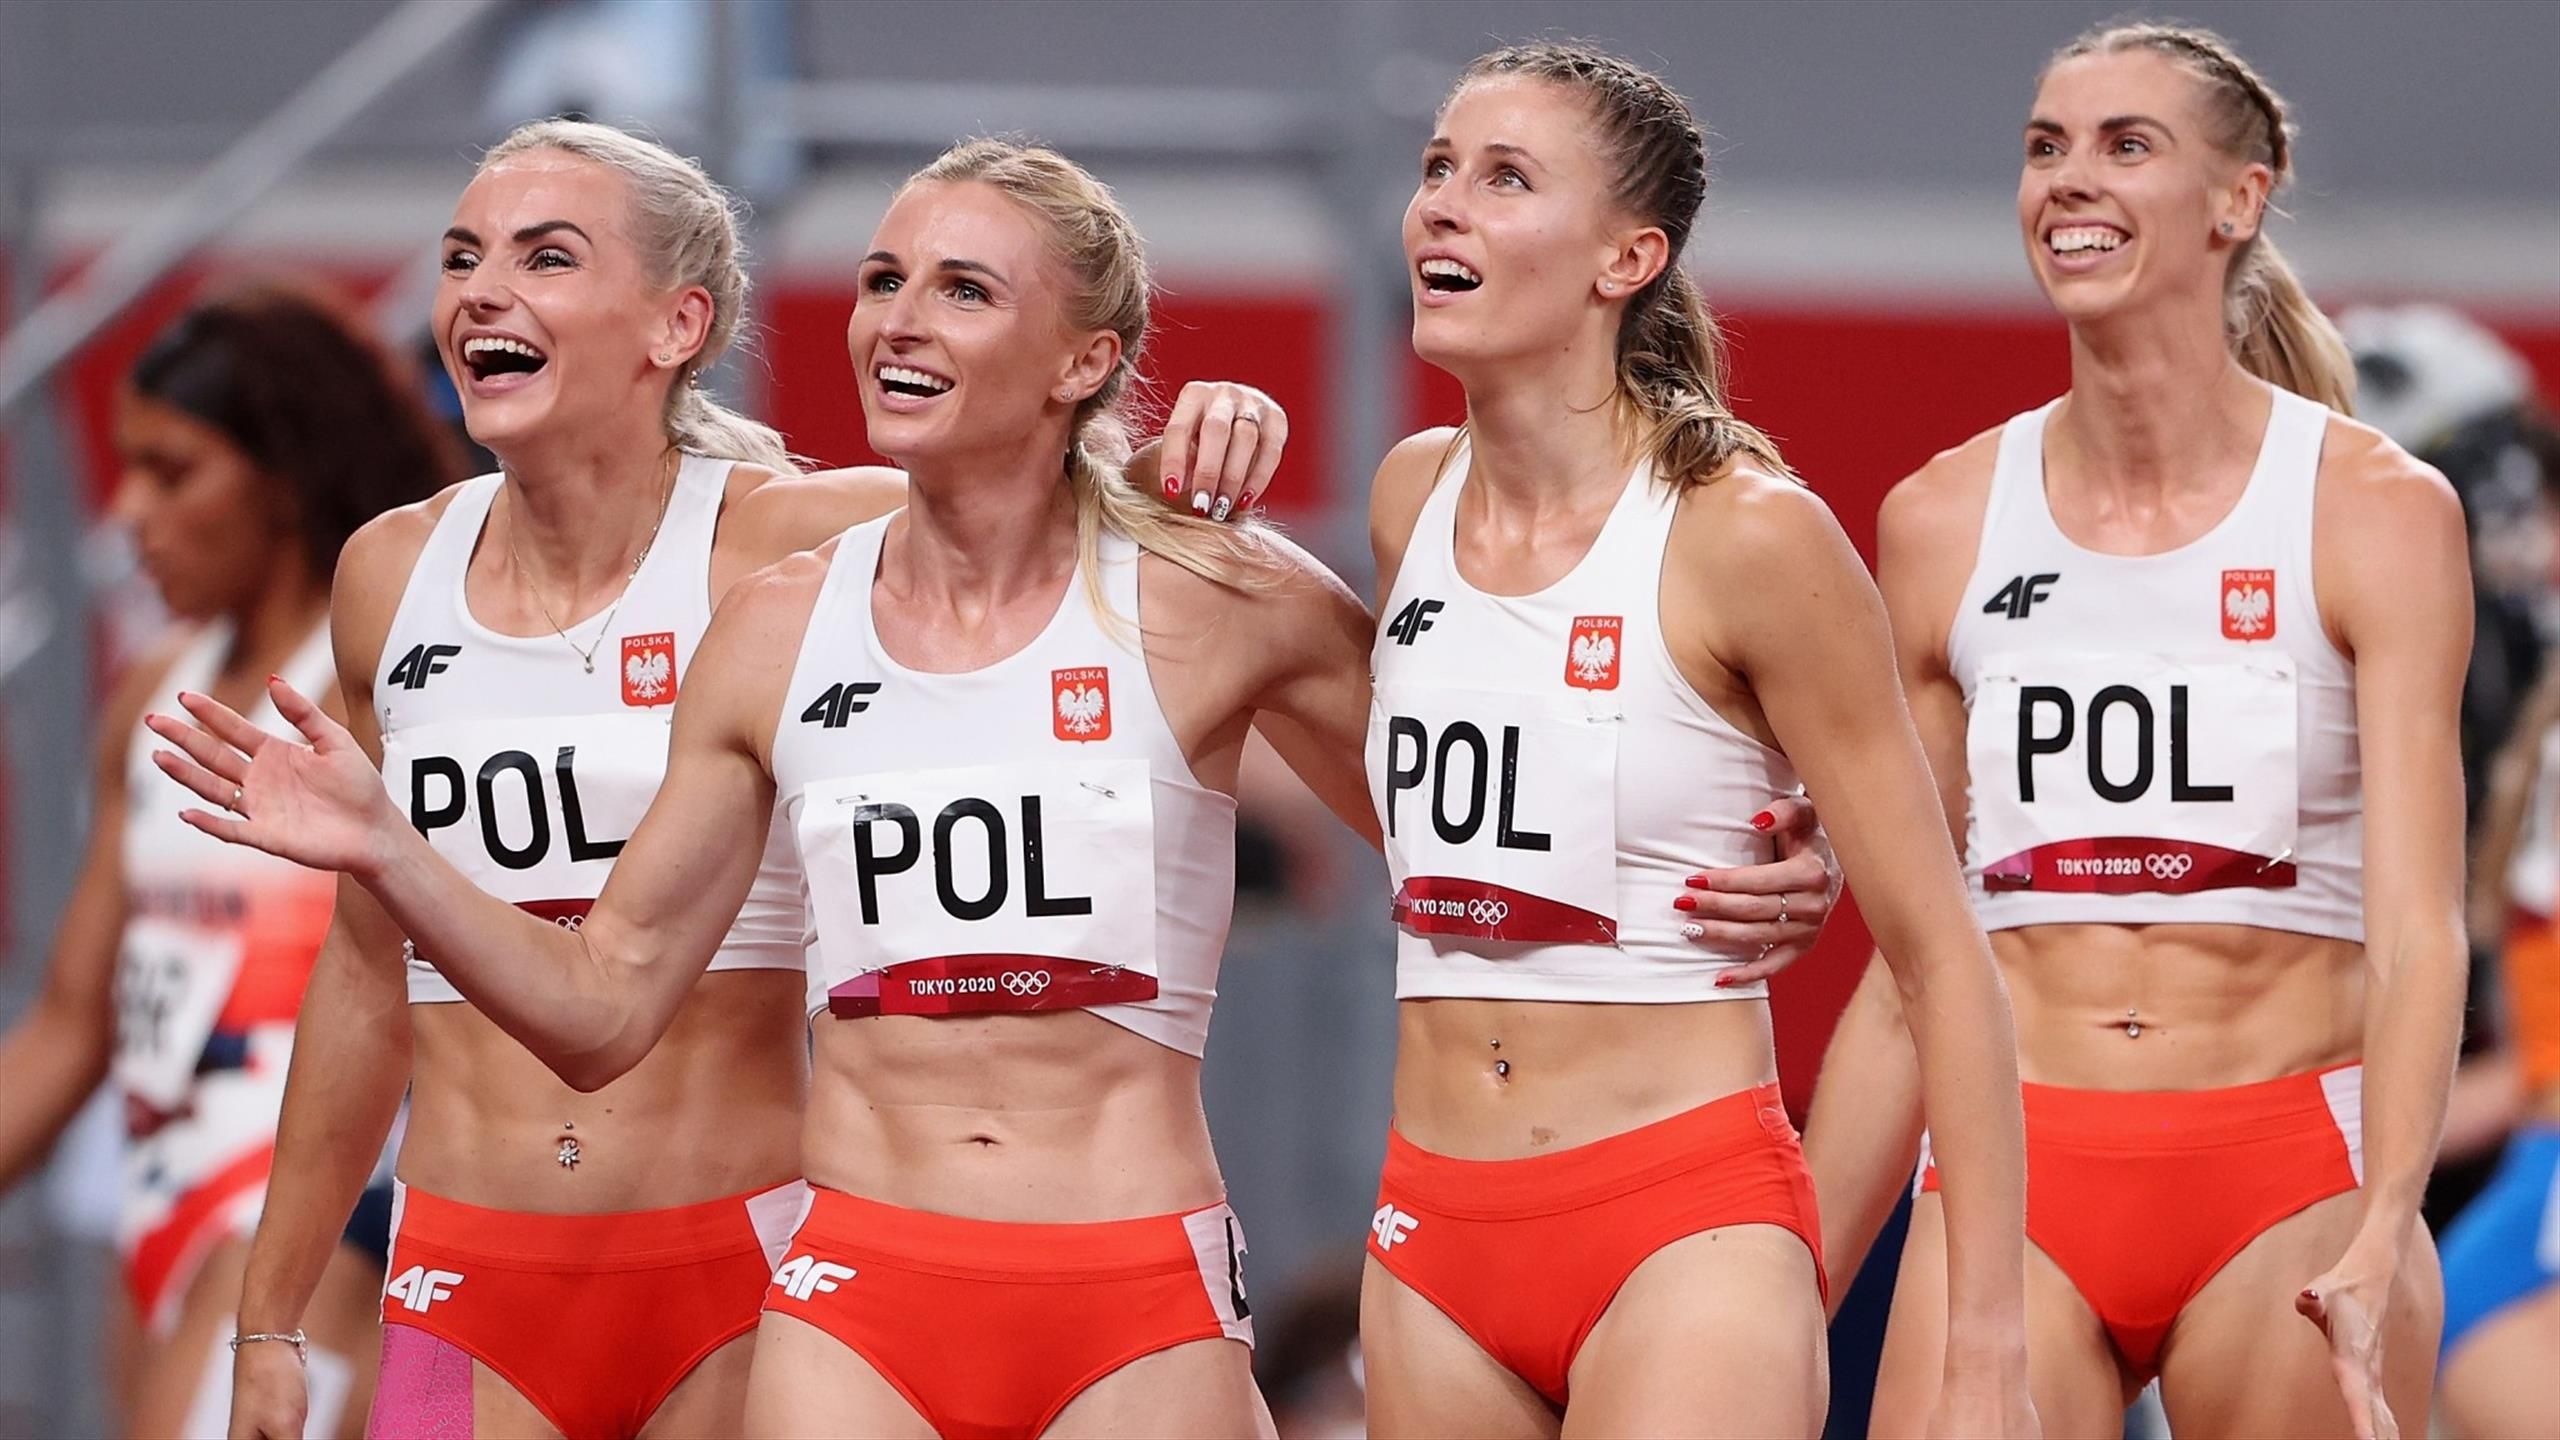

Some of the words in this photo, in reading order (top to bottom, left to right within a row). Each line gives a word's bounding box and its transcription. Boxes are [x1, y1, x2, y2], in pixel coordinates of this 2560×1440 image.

[1983, 573, 2060, 619] 4F
[2225, 572, 2271, 582] POLSKA
[625, 636, 671, 648] POLSKA
[1386, 598, 1445, 645] 4F
[1575, 618, 1618, 629] POLSKA
[388, 644, 462, 690] 4F
[1055, 670, 1104, 682] POLSKA
[800, 682, 882, 728] 4F
[2018, 684, 2233, 803] POL
[1387, 716, 1551, 852] POL
[411, 745, 627, 870] POL
[853, 795, 1092, 924] POL
[2056, 858, 2103, 875] TOKYO
[2105, 858, 2141, 874] 2020
[1438, 900, 1465, 917] 2020
[909, 979, 955, 995] TOKYO
[958, 977, 996, 993] 2020
[1372, 1203, 1419, 1252] 4F
[388, 1265, 464, 1313] 4F
[772, 1255, 857, 1302] 4F
